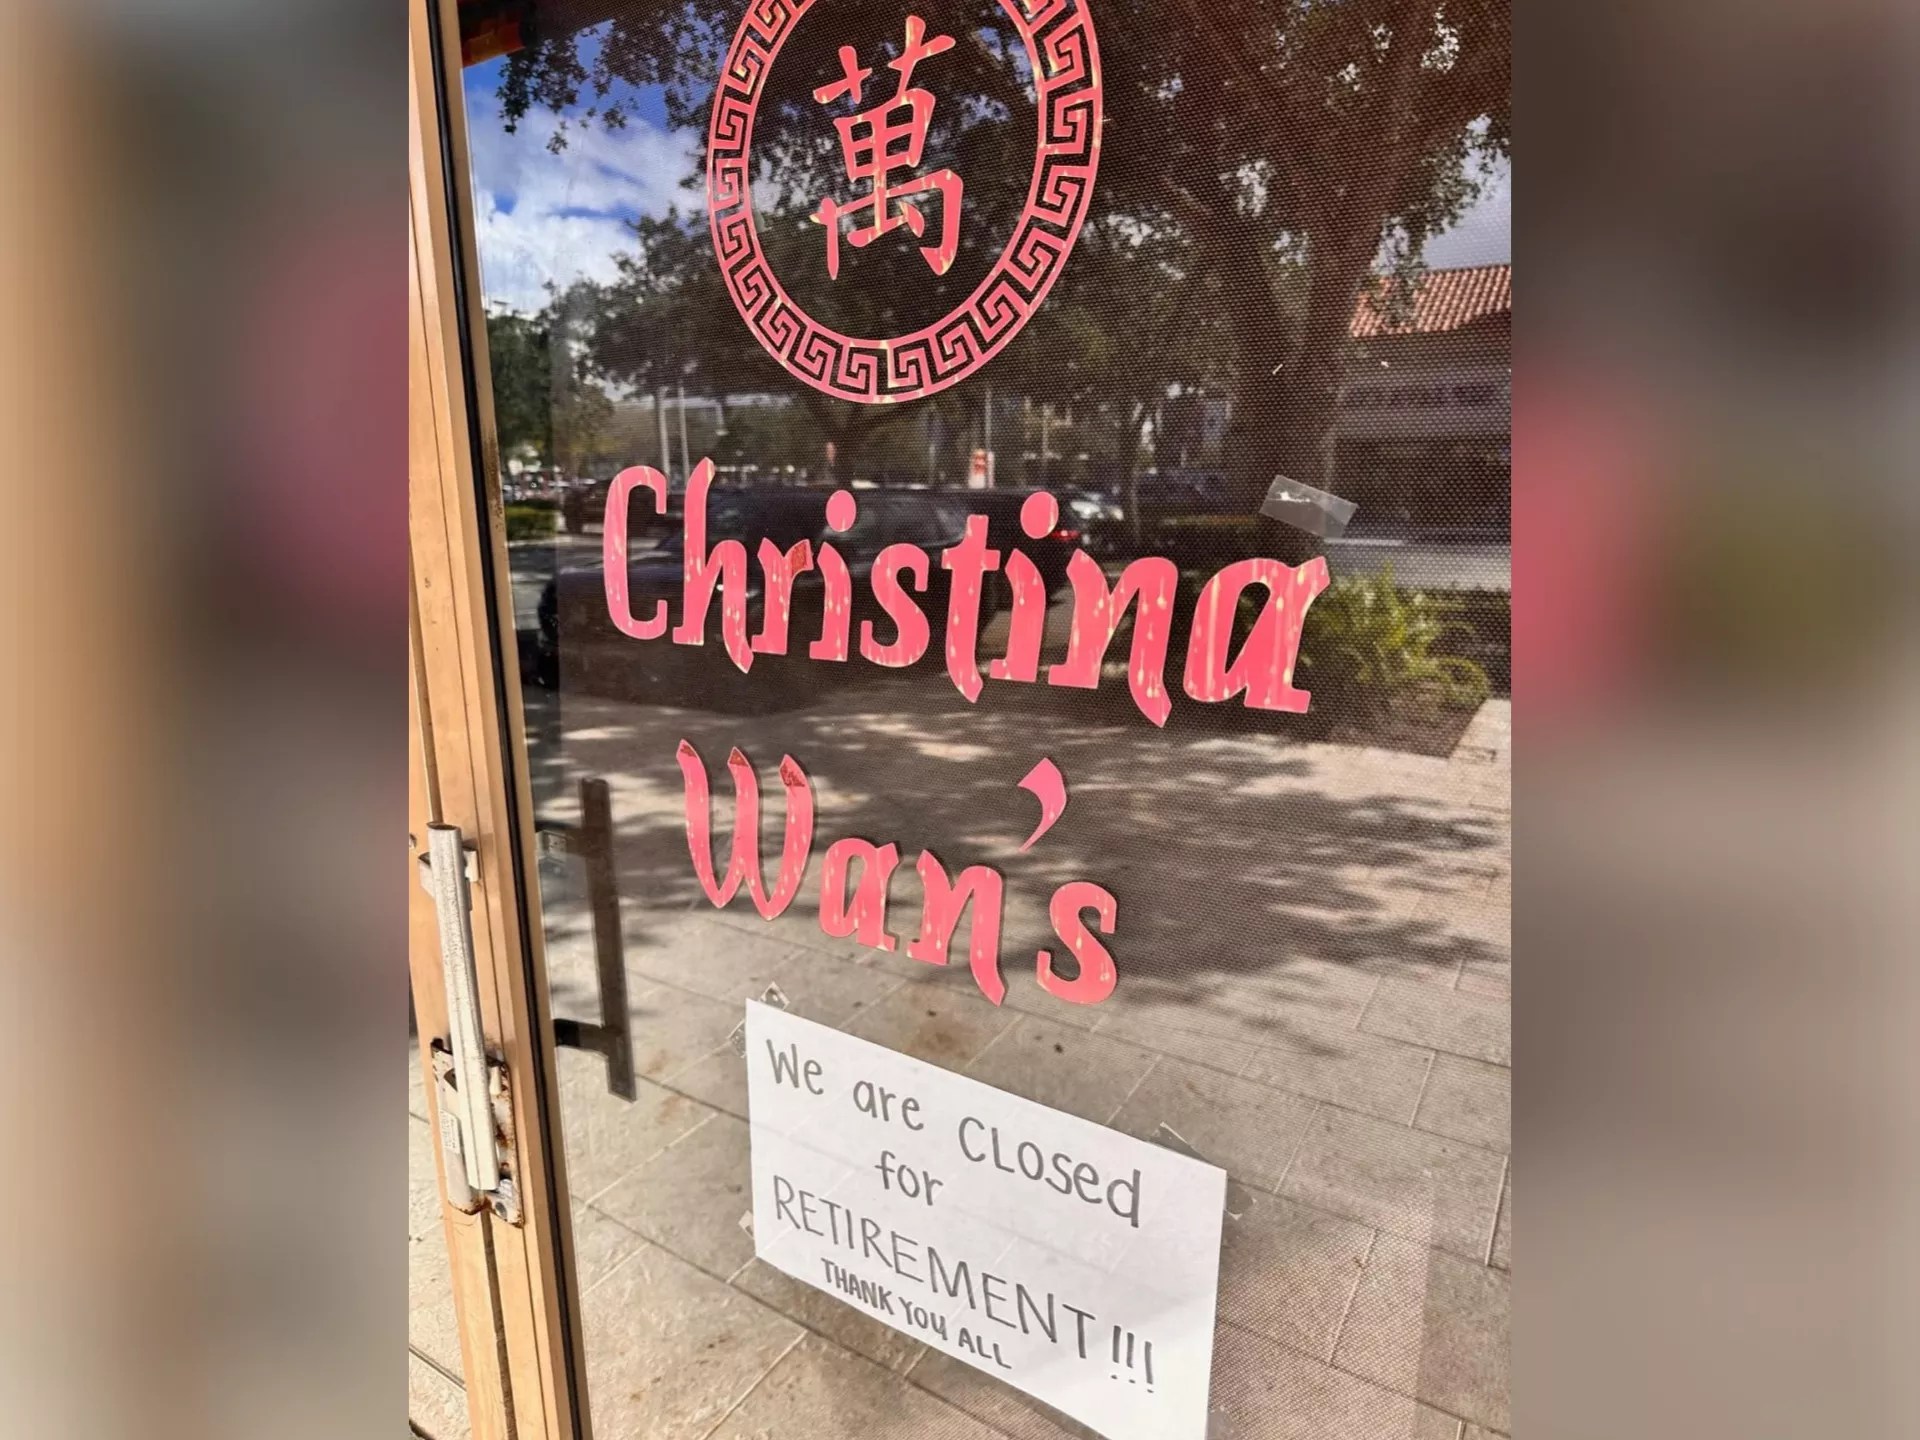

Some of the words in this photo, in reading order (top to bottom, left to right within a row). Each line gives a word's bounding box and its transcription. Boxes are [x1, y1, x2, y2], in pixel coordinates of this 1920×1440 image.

[810, 15, 963, 281] 萬
[603, 457, 1331, 727] Christina
[676, 739, 1118, 1006] Wan's
[766, 1038, 824, 1095] We
[853, 1079, 924, 1131] are
[875, 1150, 943, 1206] for
[821, 1257, 894, 1314] THANK
[958, 1328, 1012, 1370] ALL
